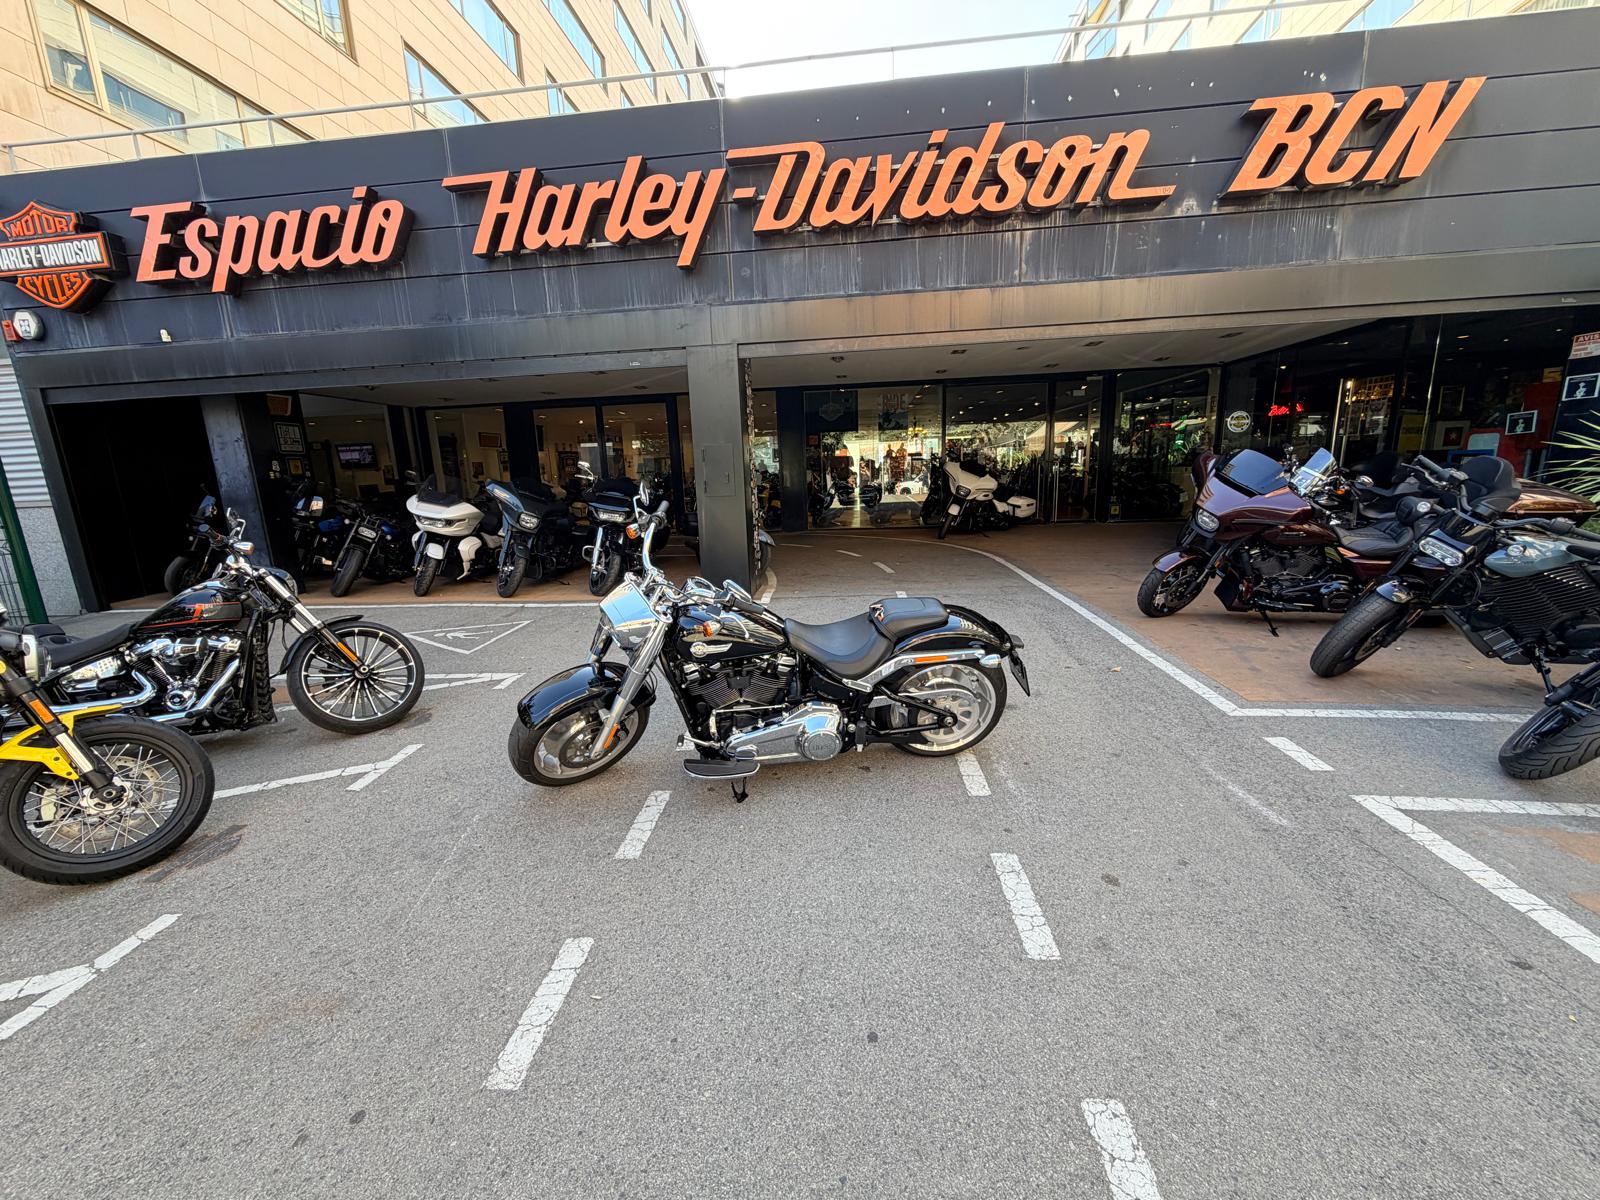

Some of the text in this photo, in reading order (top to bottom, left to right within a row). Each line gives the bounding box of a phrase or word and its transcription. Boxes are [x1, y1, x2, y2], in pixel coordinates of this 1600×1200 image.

[130, 76, 1487, 292] Espacio Harley-Davidson BCN
[10, 209, 69, 237] MOTOR
[0, 239, 101, 270] ARLEY-DAVIDSON
[24, 271, 82, 303] CYCLES
